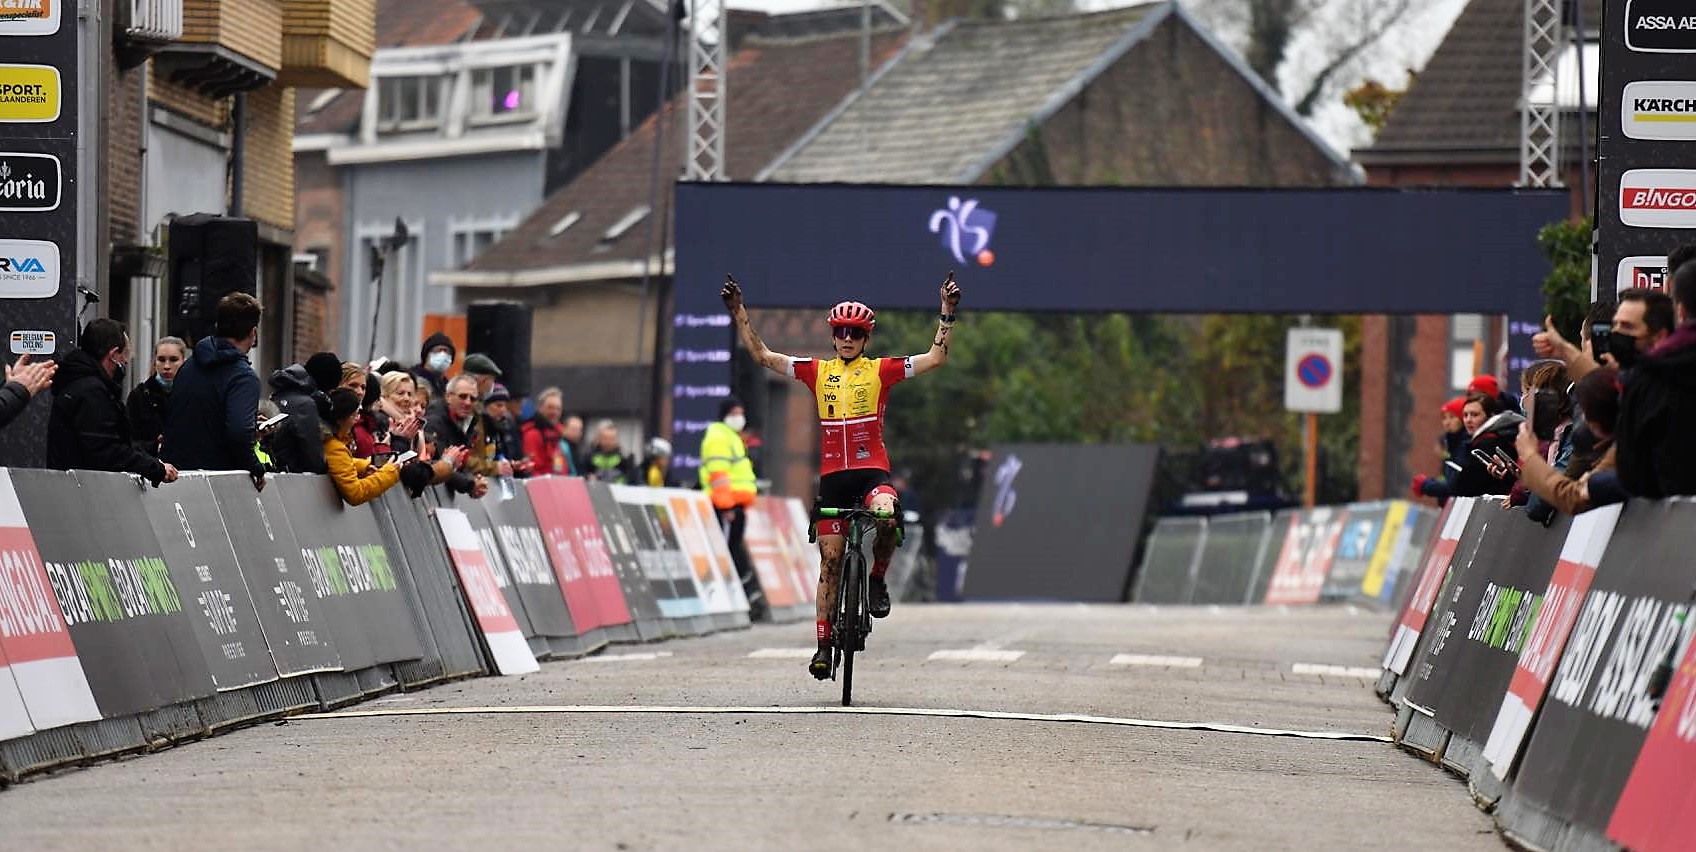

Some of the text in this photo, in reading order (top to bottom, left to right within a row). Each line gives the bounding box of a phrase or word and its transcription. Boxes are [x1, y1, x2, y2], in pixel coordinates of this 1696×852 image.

[1635, 16, 1676, 30] ASSA
[0, 84, 47, 96] PORT.
[1634, 98, 1696, 112] KÄRCH
[0, 257, 46, 272] RVA
[1588, 596, 1662, 719] ASSA
